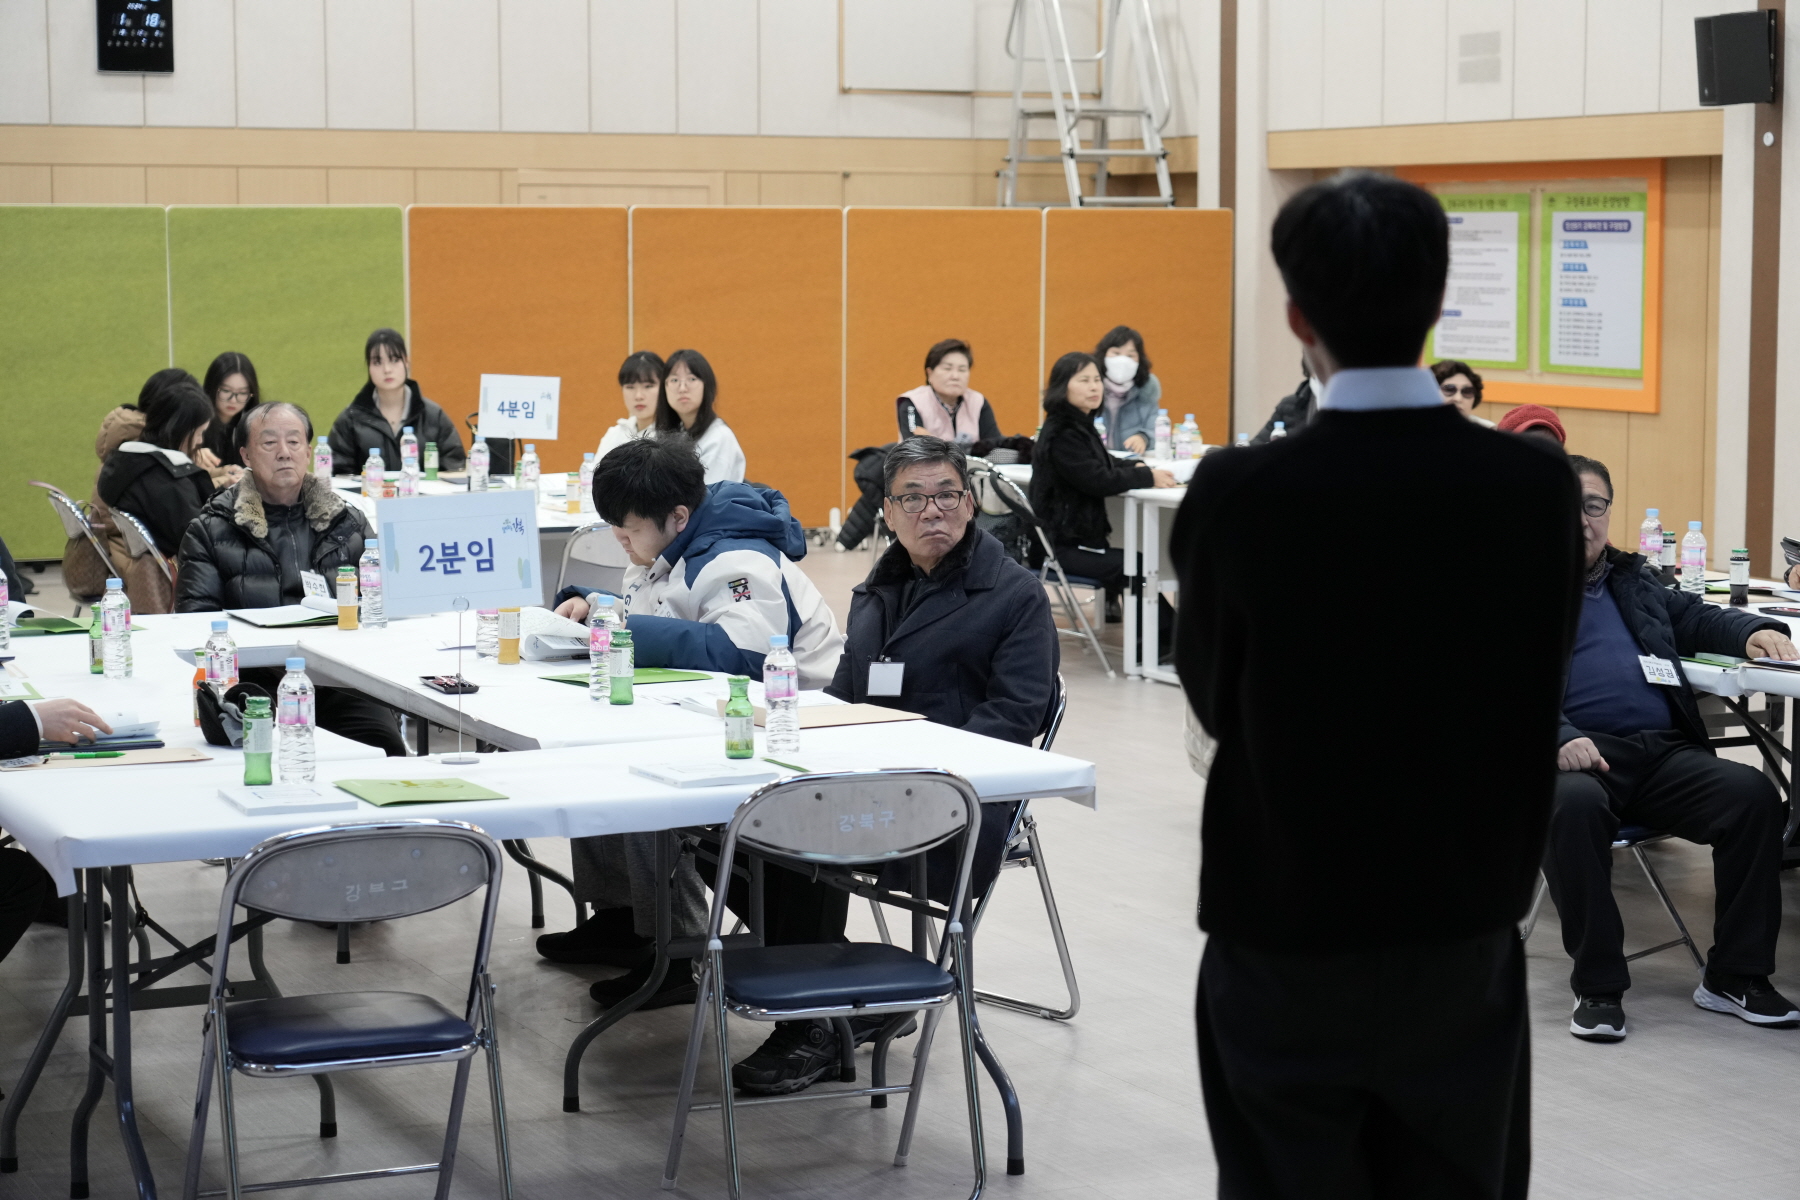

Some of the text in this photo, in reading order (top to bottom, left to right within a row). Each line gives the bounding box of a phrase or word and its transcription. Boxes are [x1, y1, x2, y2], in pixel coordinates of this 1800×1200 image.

[145, 12, 161, 27] 18
[497, 400, 535, 419] 4분임
[418, 537, 495, 575] 2분임
[1645, 665, 1675, 679] 김성권
[839, 810, 896, 832] 강북구
